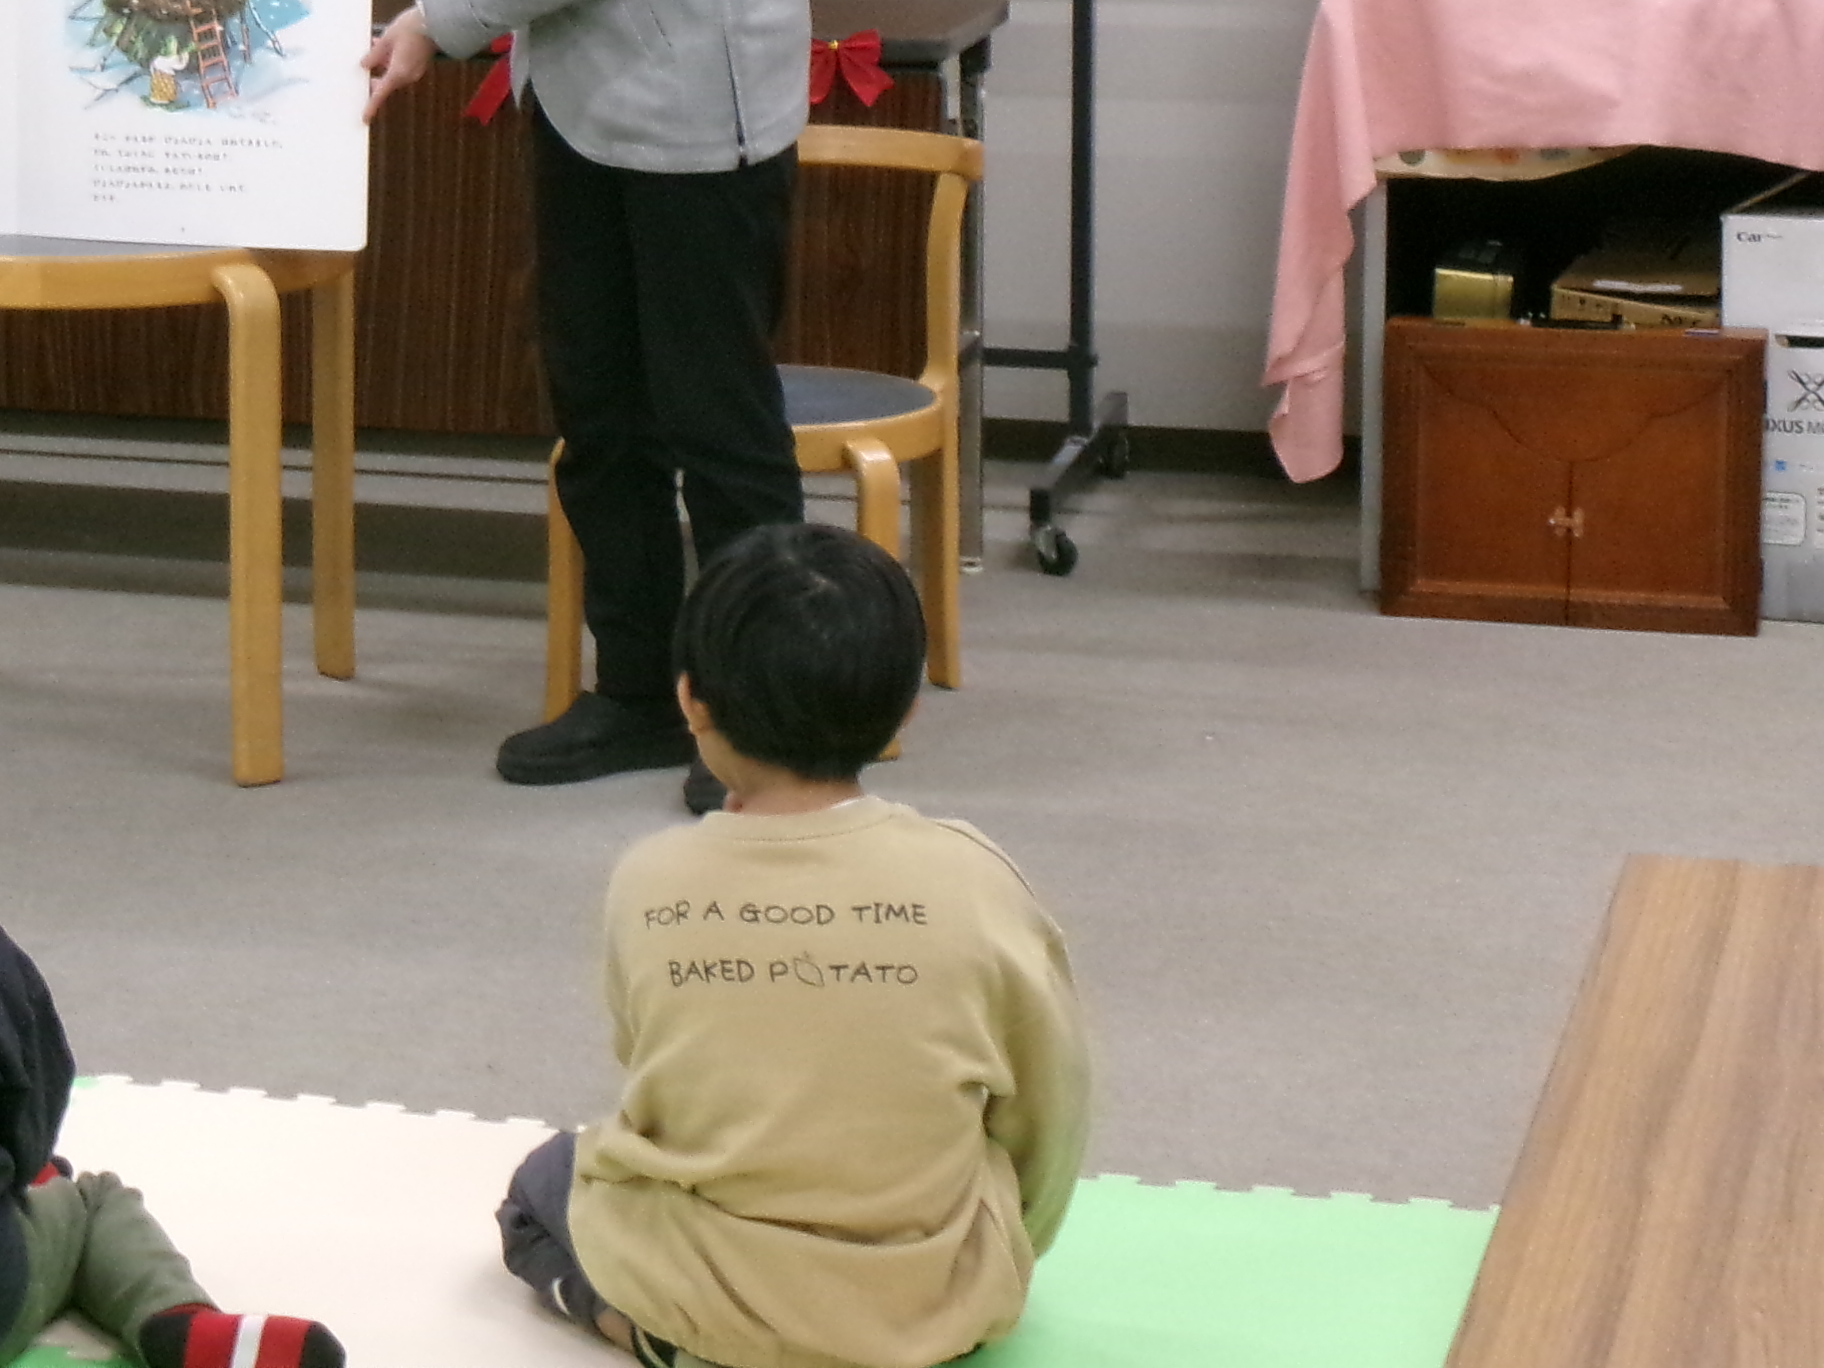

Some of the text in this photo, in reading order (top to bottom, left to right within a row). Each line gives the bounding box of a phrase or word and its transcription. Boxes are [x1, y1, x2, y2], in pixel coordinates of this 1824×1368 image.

[644, 899, 928, 930] FOR A GOOD TIME
[668, 959, 755, 988] BAKED
